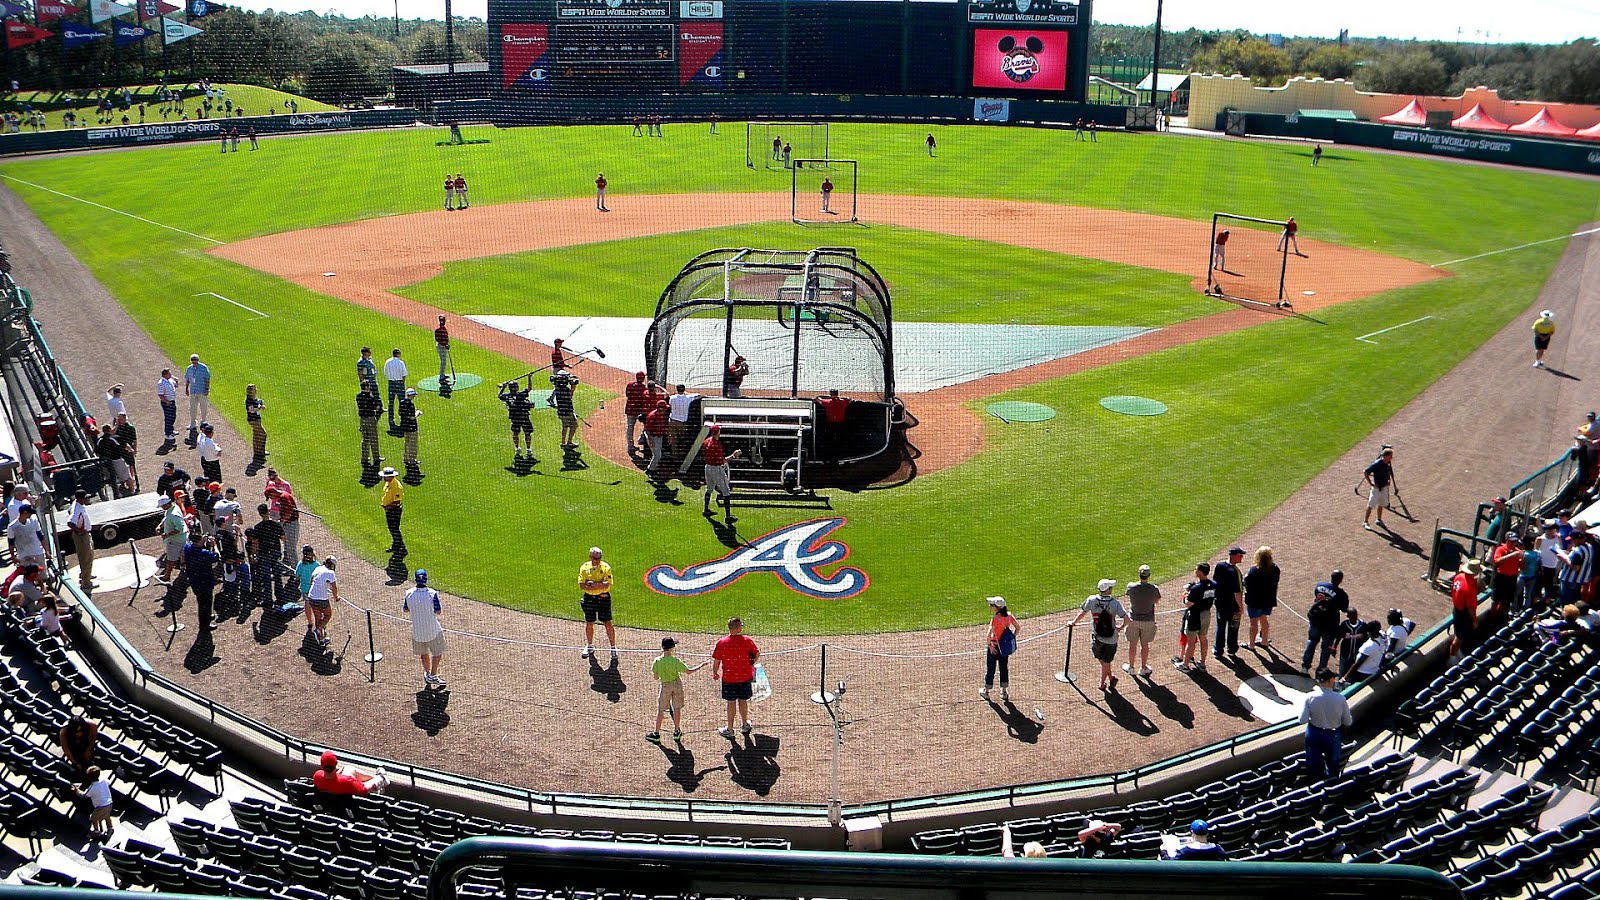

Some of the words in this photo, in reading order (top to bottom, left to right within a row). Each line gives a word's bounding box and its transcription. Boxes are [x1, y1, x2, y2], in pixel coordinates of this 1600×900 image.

[41, 6, 65, 14] TORO
[194, 4, 205, 16] hp
[640, 8, 666, 16] SPORTS
[971, 12, 994, 20] ESPN
[1015, 13, 1040, 21] WORLD
[1048, 14, 1075, 22] SPORTS
[64, 31, 106, 39] Champion
[503, 34, 546, 43] Champion
[681, 33, 721, 41] Champion
[332, 115, 351, 123] World
[87, 129, 119, 140] ESPN
[119, 127, 145, 137] WIDE
[145, 125, 178, 136] WORLD
[187, 122, 220, 133] SPORTS
[1393, 130, 1418, 141] ESPN
[1419, 133, 1441, 144] WIDE
[1441, 135, 1469, 148] WORLD
[1479, 140, 1511, 152] SPORTS
[643, 516, 871, 600] A
